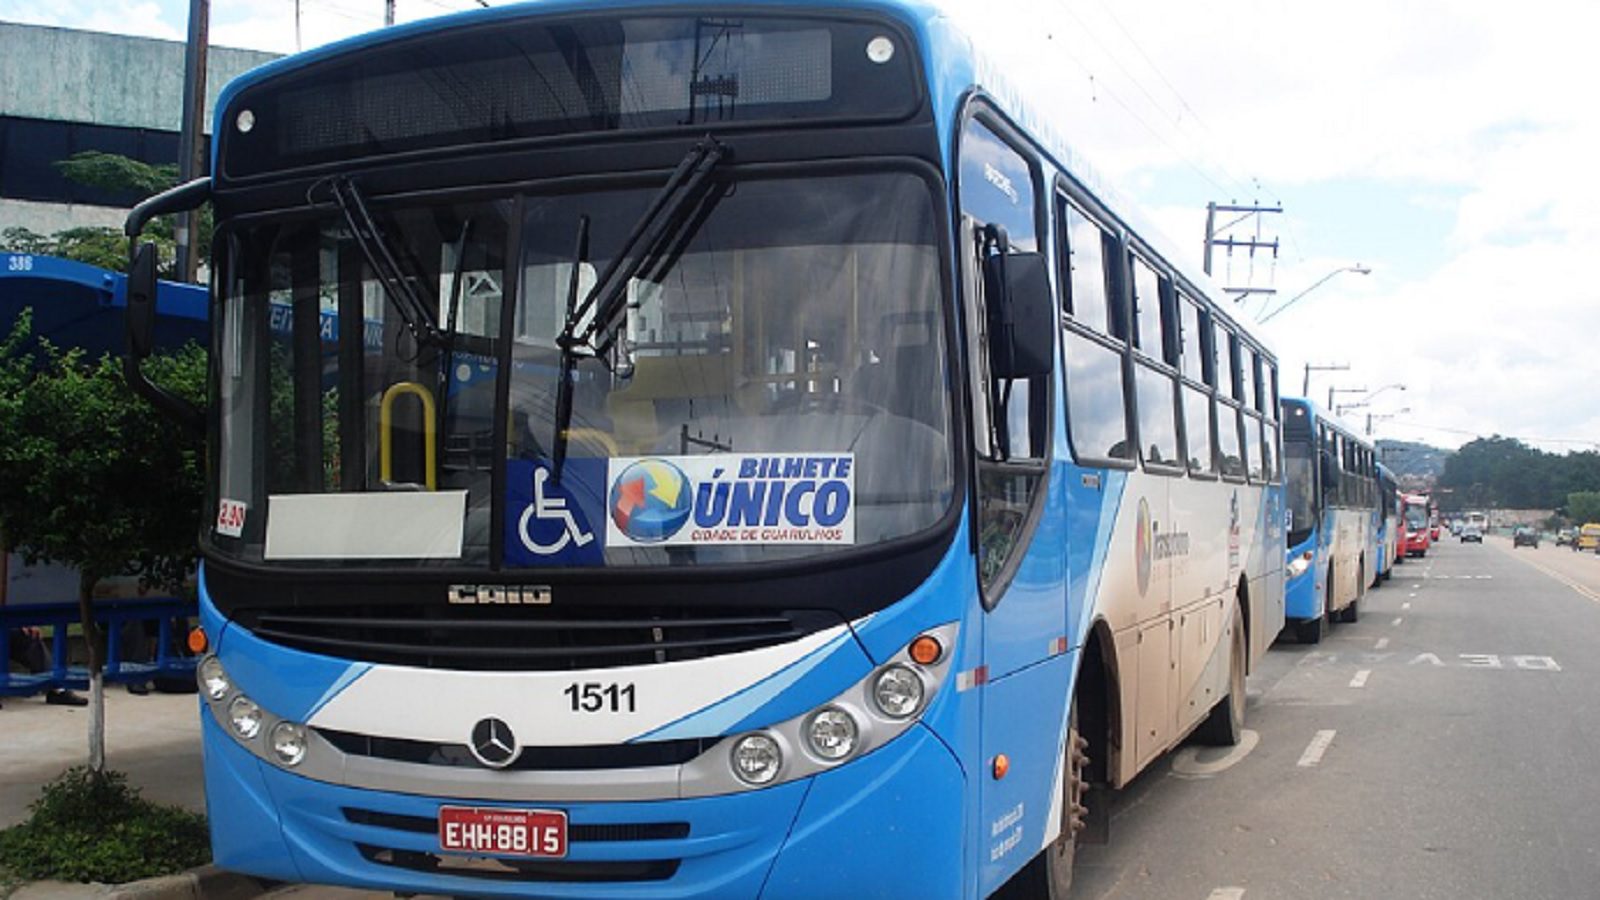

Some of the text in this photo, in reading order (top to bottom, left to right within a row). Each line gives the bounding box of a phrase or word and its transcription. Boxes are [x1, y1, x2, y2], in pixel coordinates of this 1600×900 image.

[738, 458, 853, 479] BILHETE
[693, 468, 851, 528] ÚNICO
[691, 528, 843, 541] CIDADE DE GUARULHOS
[448, 584, 552, 604] CAIO
[564, 682, 635, 713] 1511
